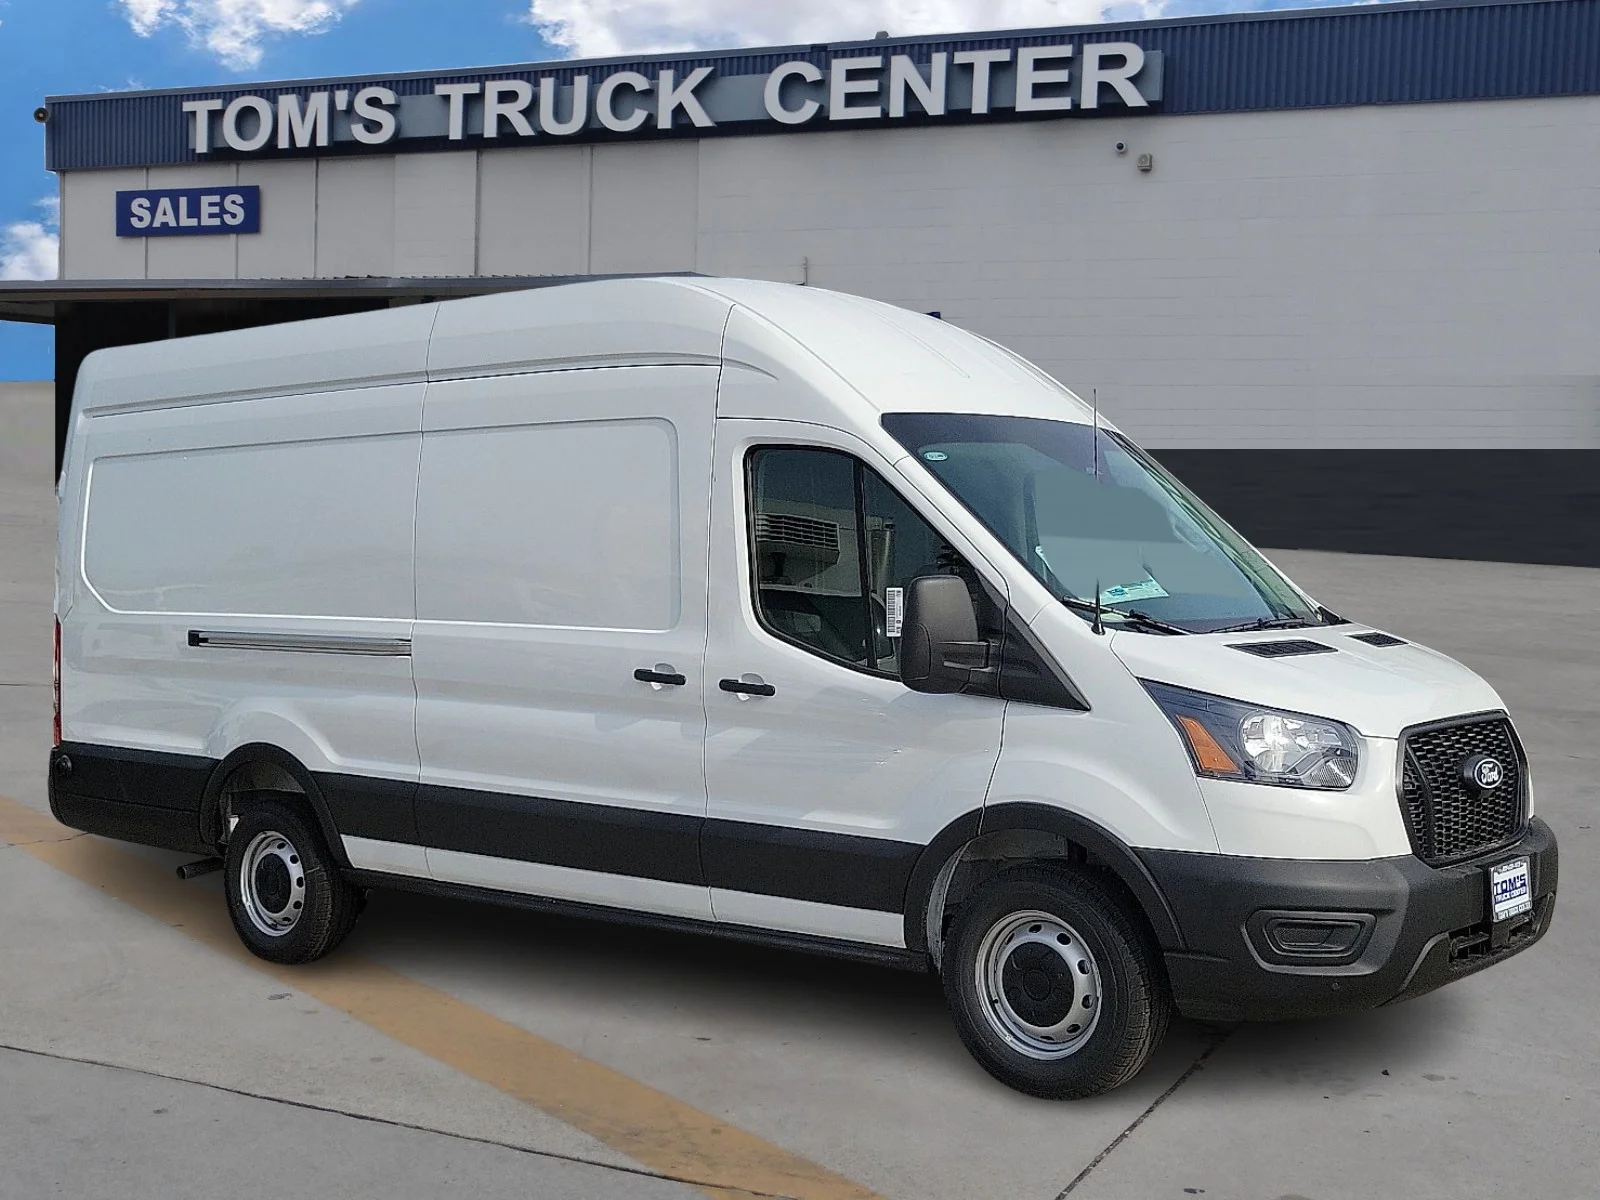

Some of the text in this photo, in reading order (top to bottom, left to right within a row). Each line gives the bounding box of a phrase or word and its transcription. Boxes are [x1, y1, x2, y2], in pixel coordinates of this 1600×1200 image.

[182, 42, 1149, 154] TOM'S TRUCK CENTER
[129, 193, 245, 229] SALES
[1481, 763, 1499, 783] Ford
[1493, 873, 1526, 896] TOM'S
